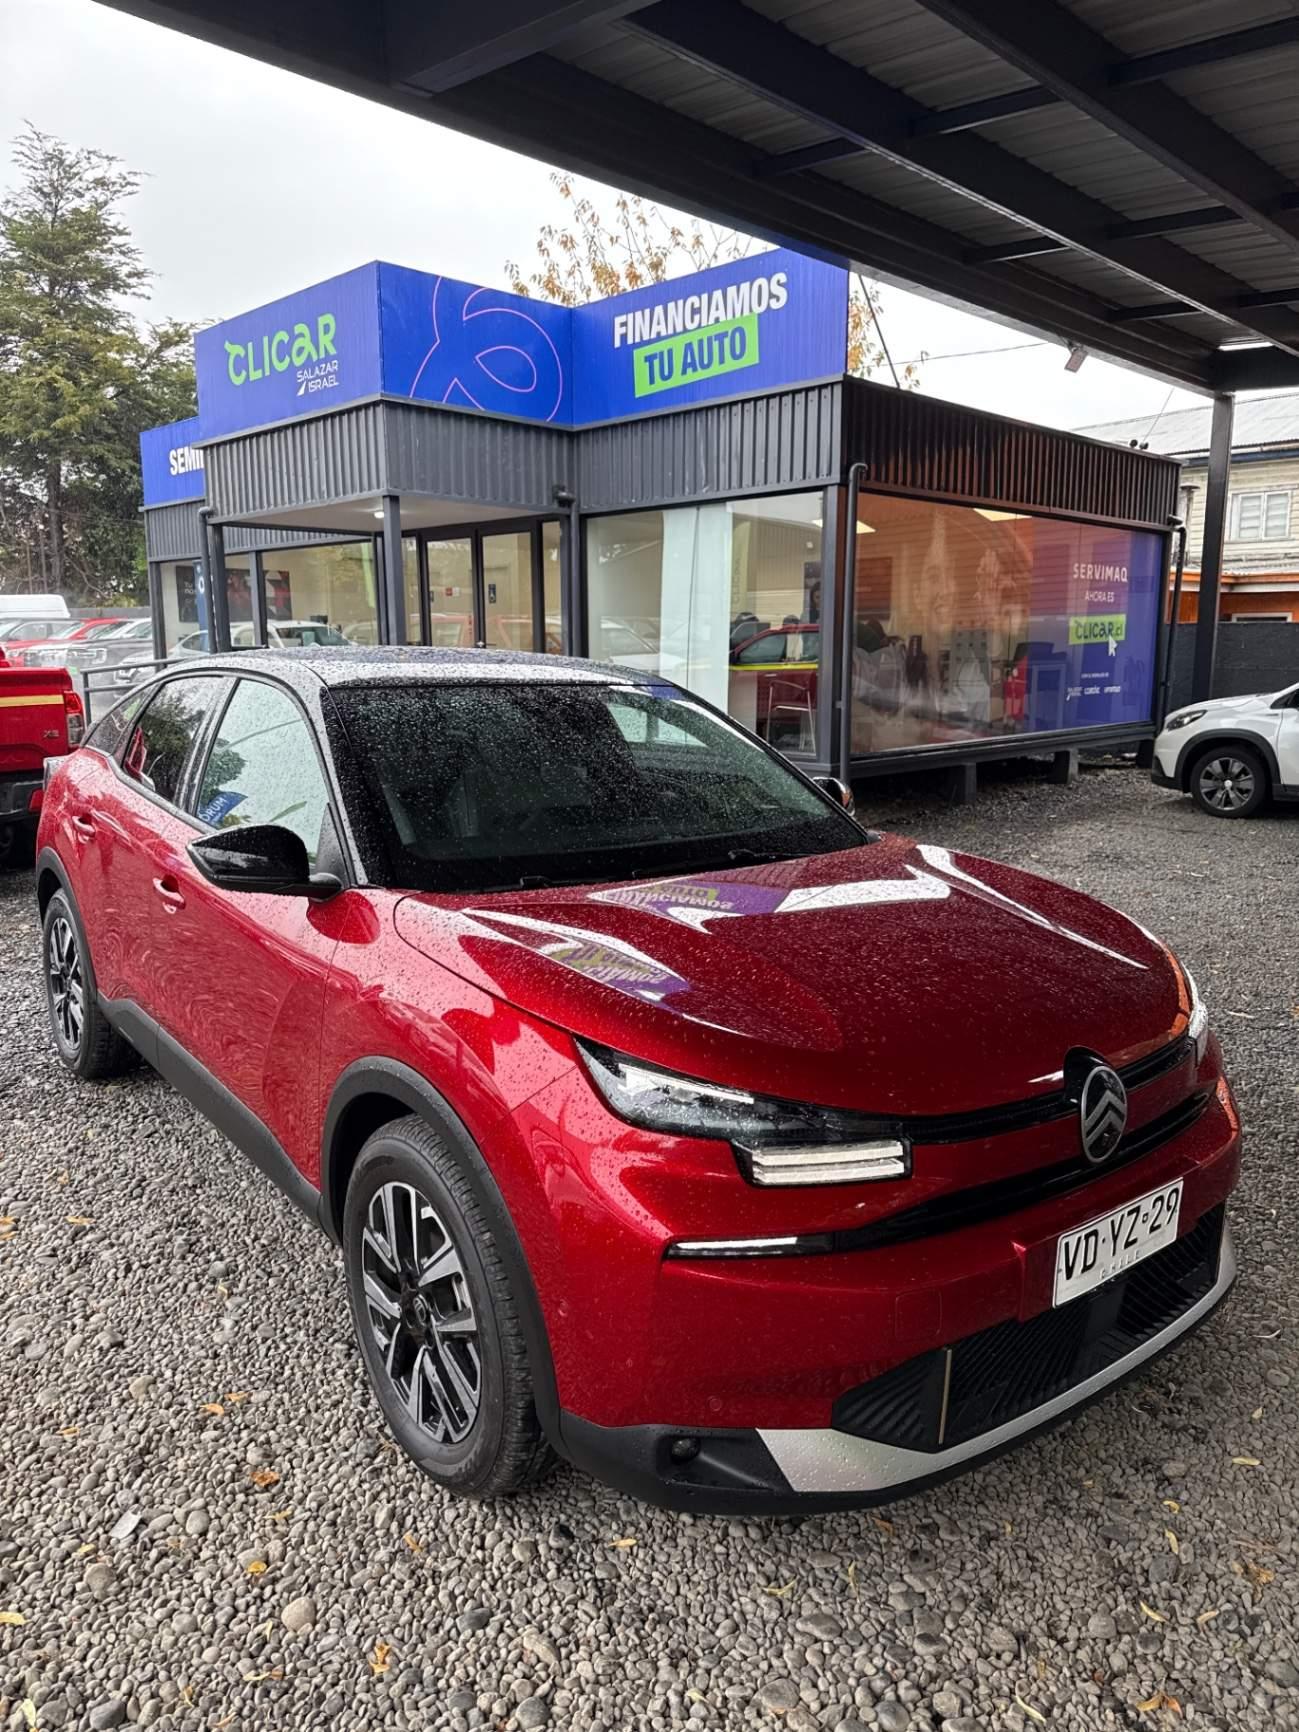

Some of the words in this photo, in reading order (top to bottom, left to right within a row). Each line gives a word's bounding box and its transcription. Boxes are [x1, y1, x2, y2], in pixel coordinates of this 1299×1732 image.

[614, 272, 788, 349] FINANCIAMOS
[644, 345, 674, 386] TU
[681, 326, 747, 376] AUTO
[296, 359, 339, 383] SALAZAR
[308, 374, 340, 393] ISRAEL
[1073, 563, 1128, 582] SERVIMAQ
[1085, 590, 1107, 602] AHORA
[1107, 591, 1115, 603] ES
[1099, 1248, 1141, 1280] CHILE
